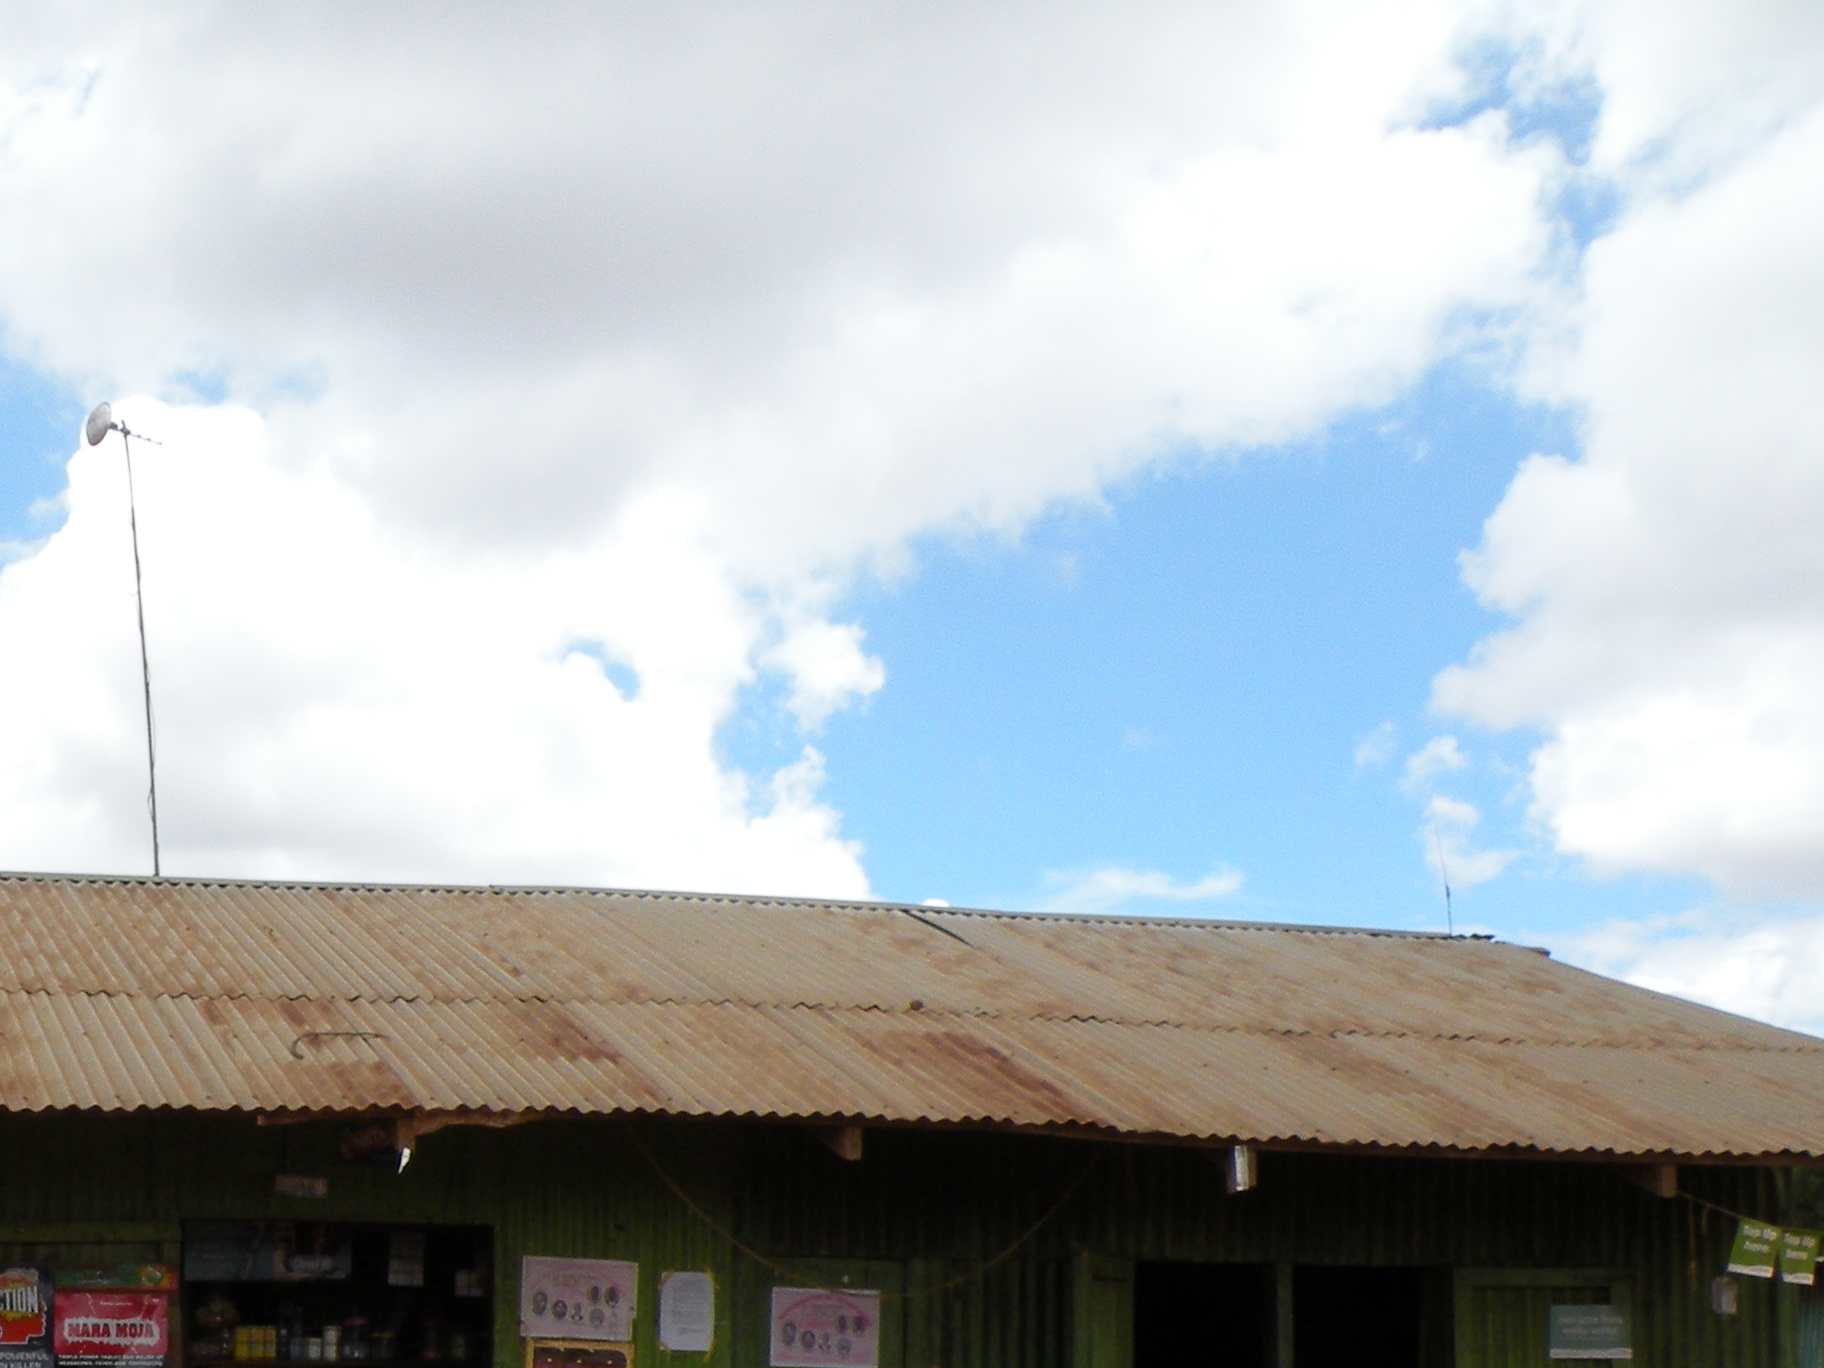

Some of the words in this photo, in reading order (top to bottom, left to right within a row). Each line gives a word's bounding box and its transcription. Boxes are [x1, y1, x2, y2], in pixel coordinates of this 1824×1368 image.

[67, 1322, 111, 1338] MARA
[114, 1322, 155, 1339] MOJA
[0, 1352, 49, 1361] POWERFUL
